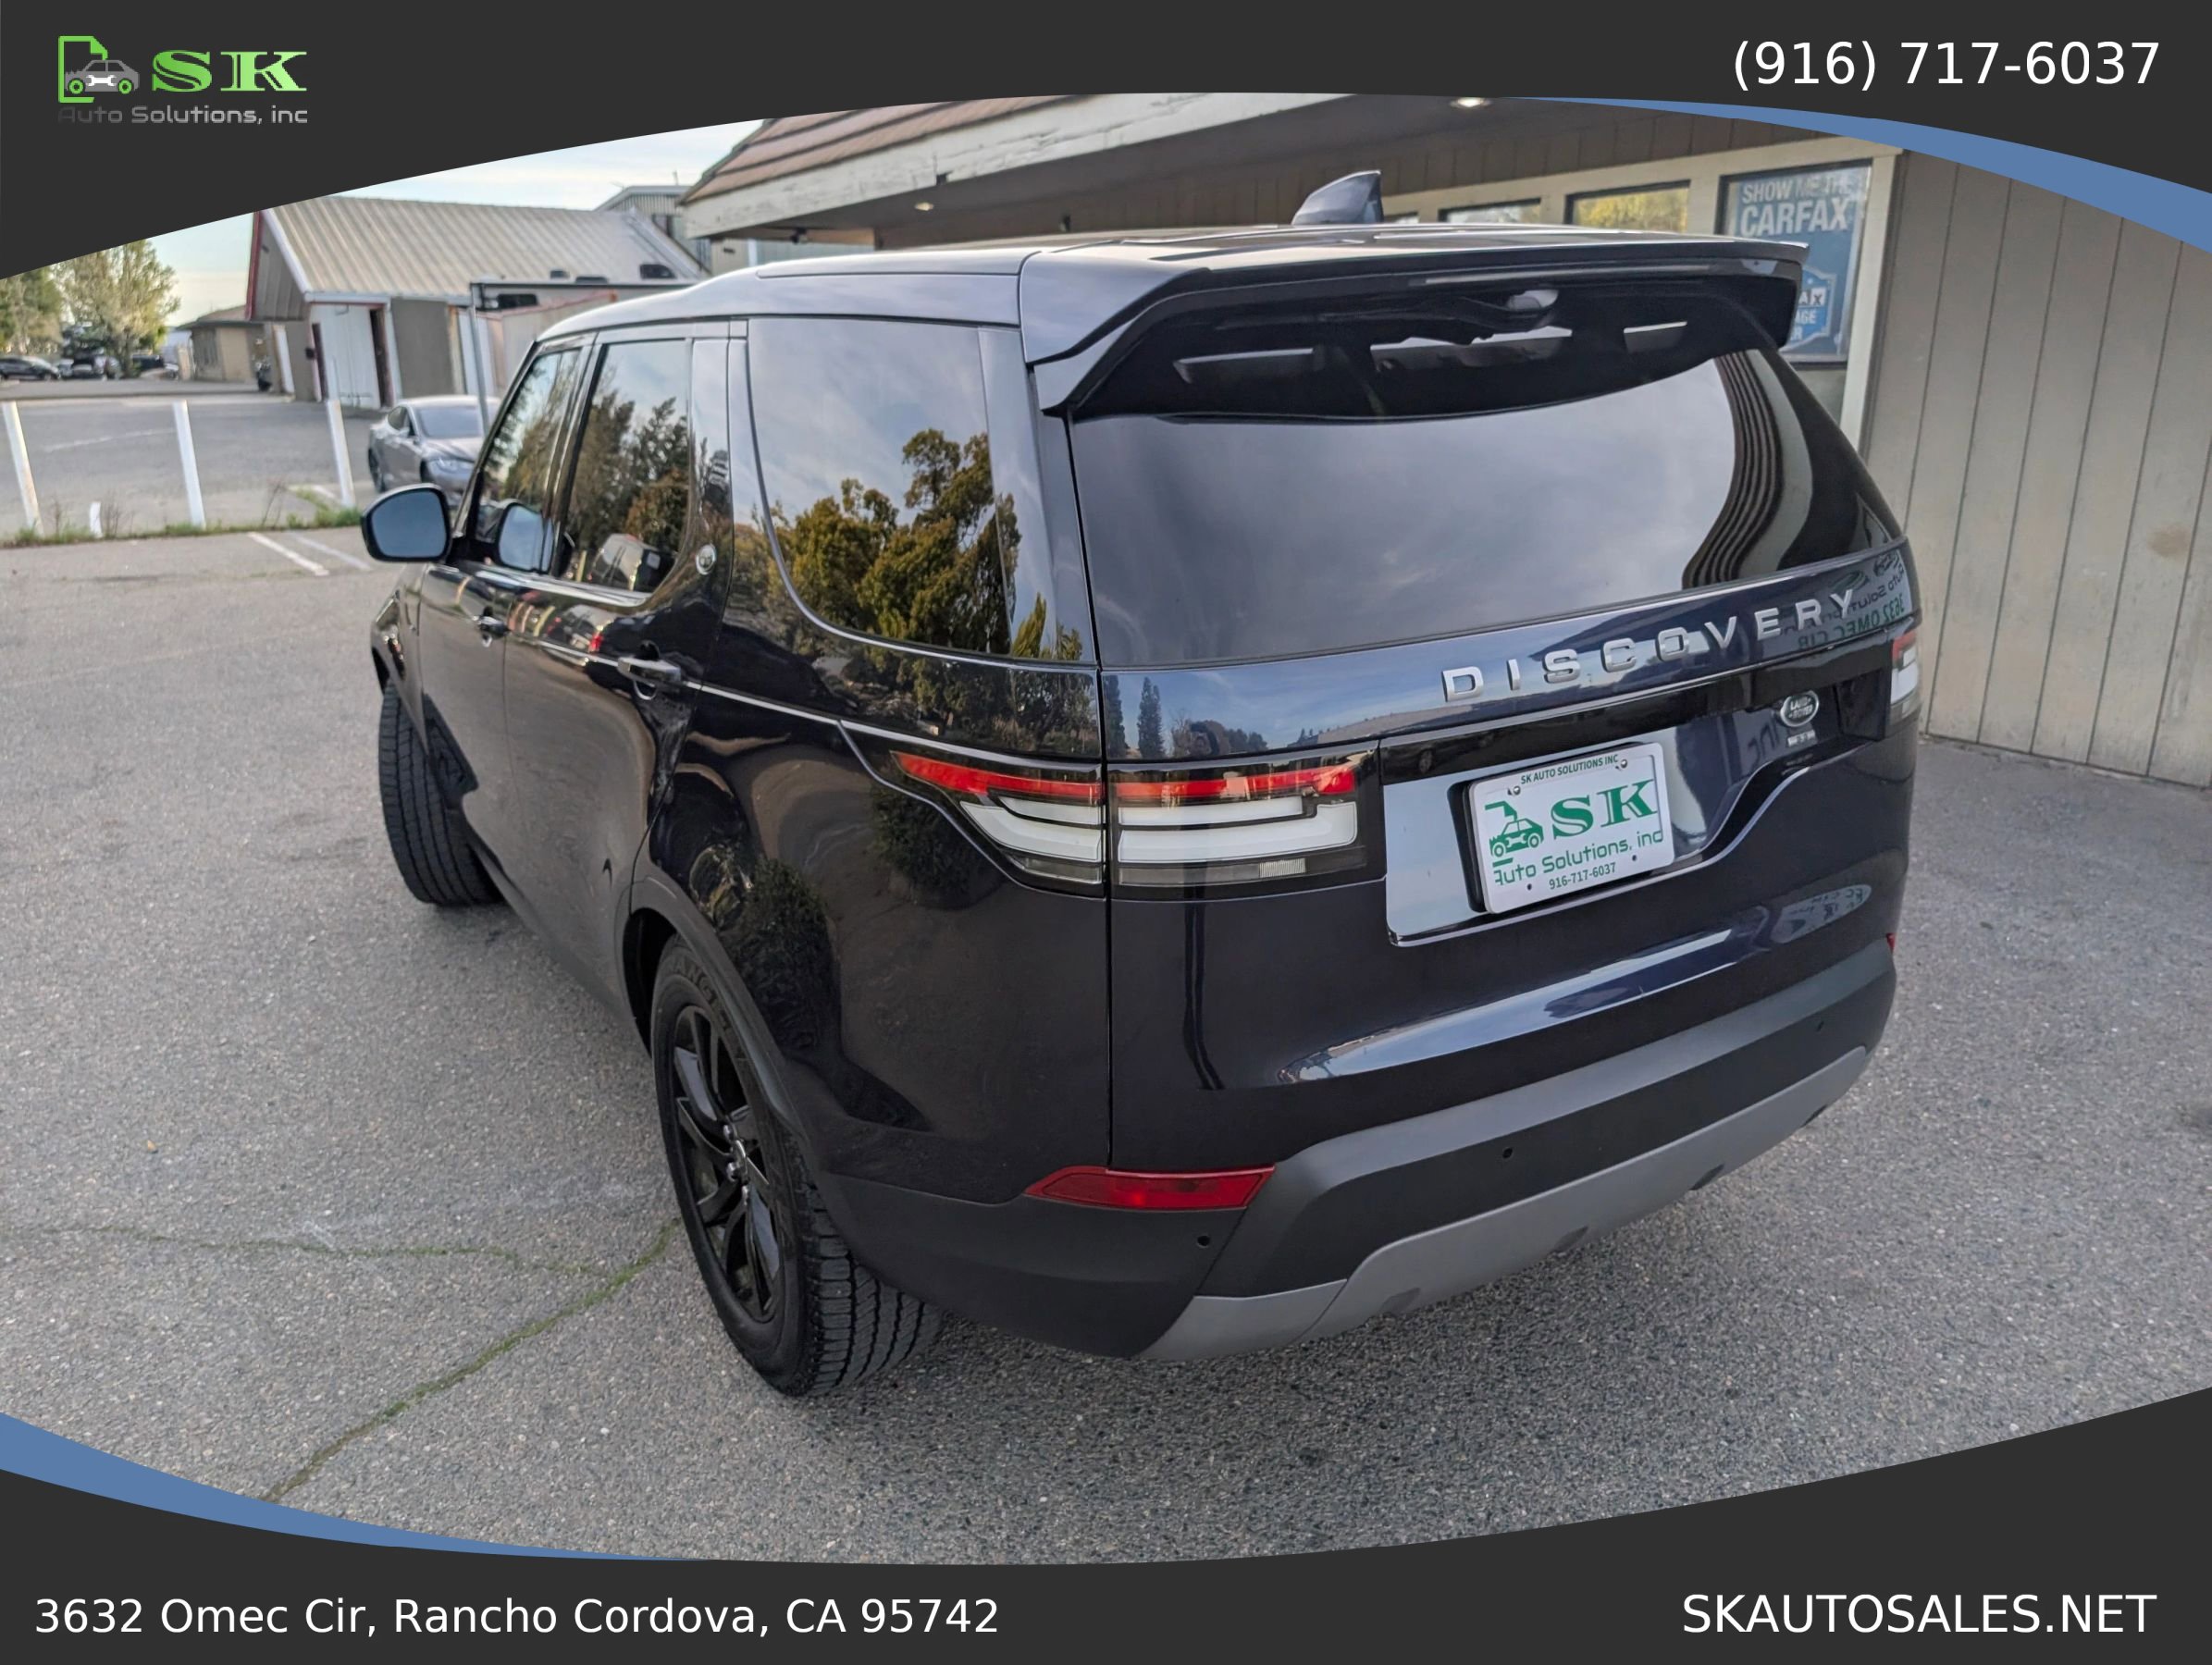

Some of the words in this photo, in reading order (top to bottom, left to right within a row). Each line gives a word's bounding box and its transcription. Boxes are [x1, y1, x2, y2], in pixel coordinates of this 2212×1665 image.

[1741, 179, 1793, 204] SHOW
[1739, 196, 1849, 239] CARFAX
[1440, 589, 1853, 703] DISCOVERY
[1520, 773, 1532, 784] SK
[1533, 769, 1556, 783] AUTO
[1557, 758, 1603, 775] SOLUTIONS
[1604, 754, 1619, 765] INC
[1551, 779, 1658, 840] SK
[1541, 839, 1633, 874] Solutions,
[1549, 862, 1616, 890] 916-717-6037
